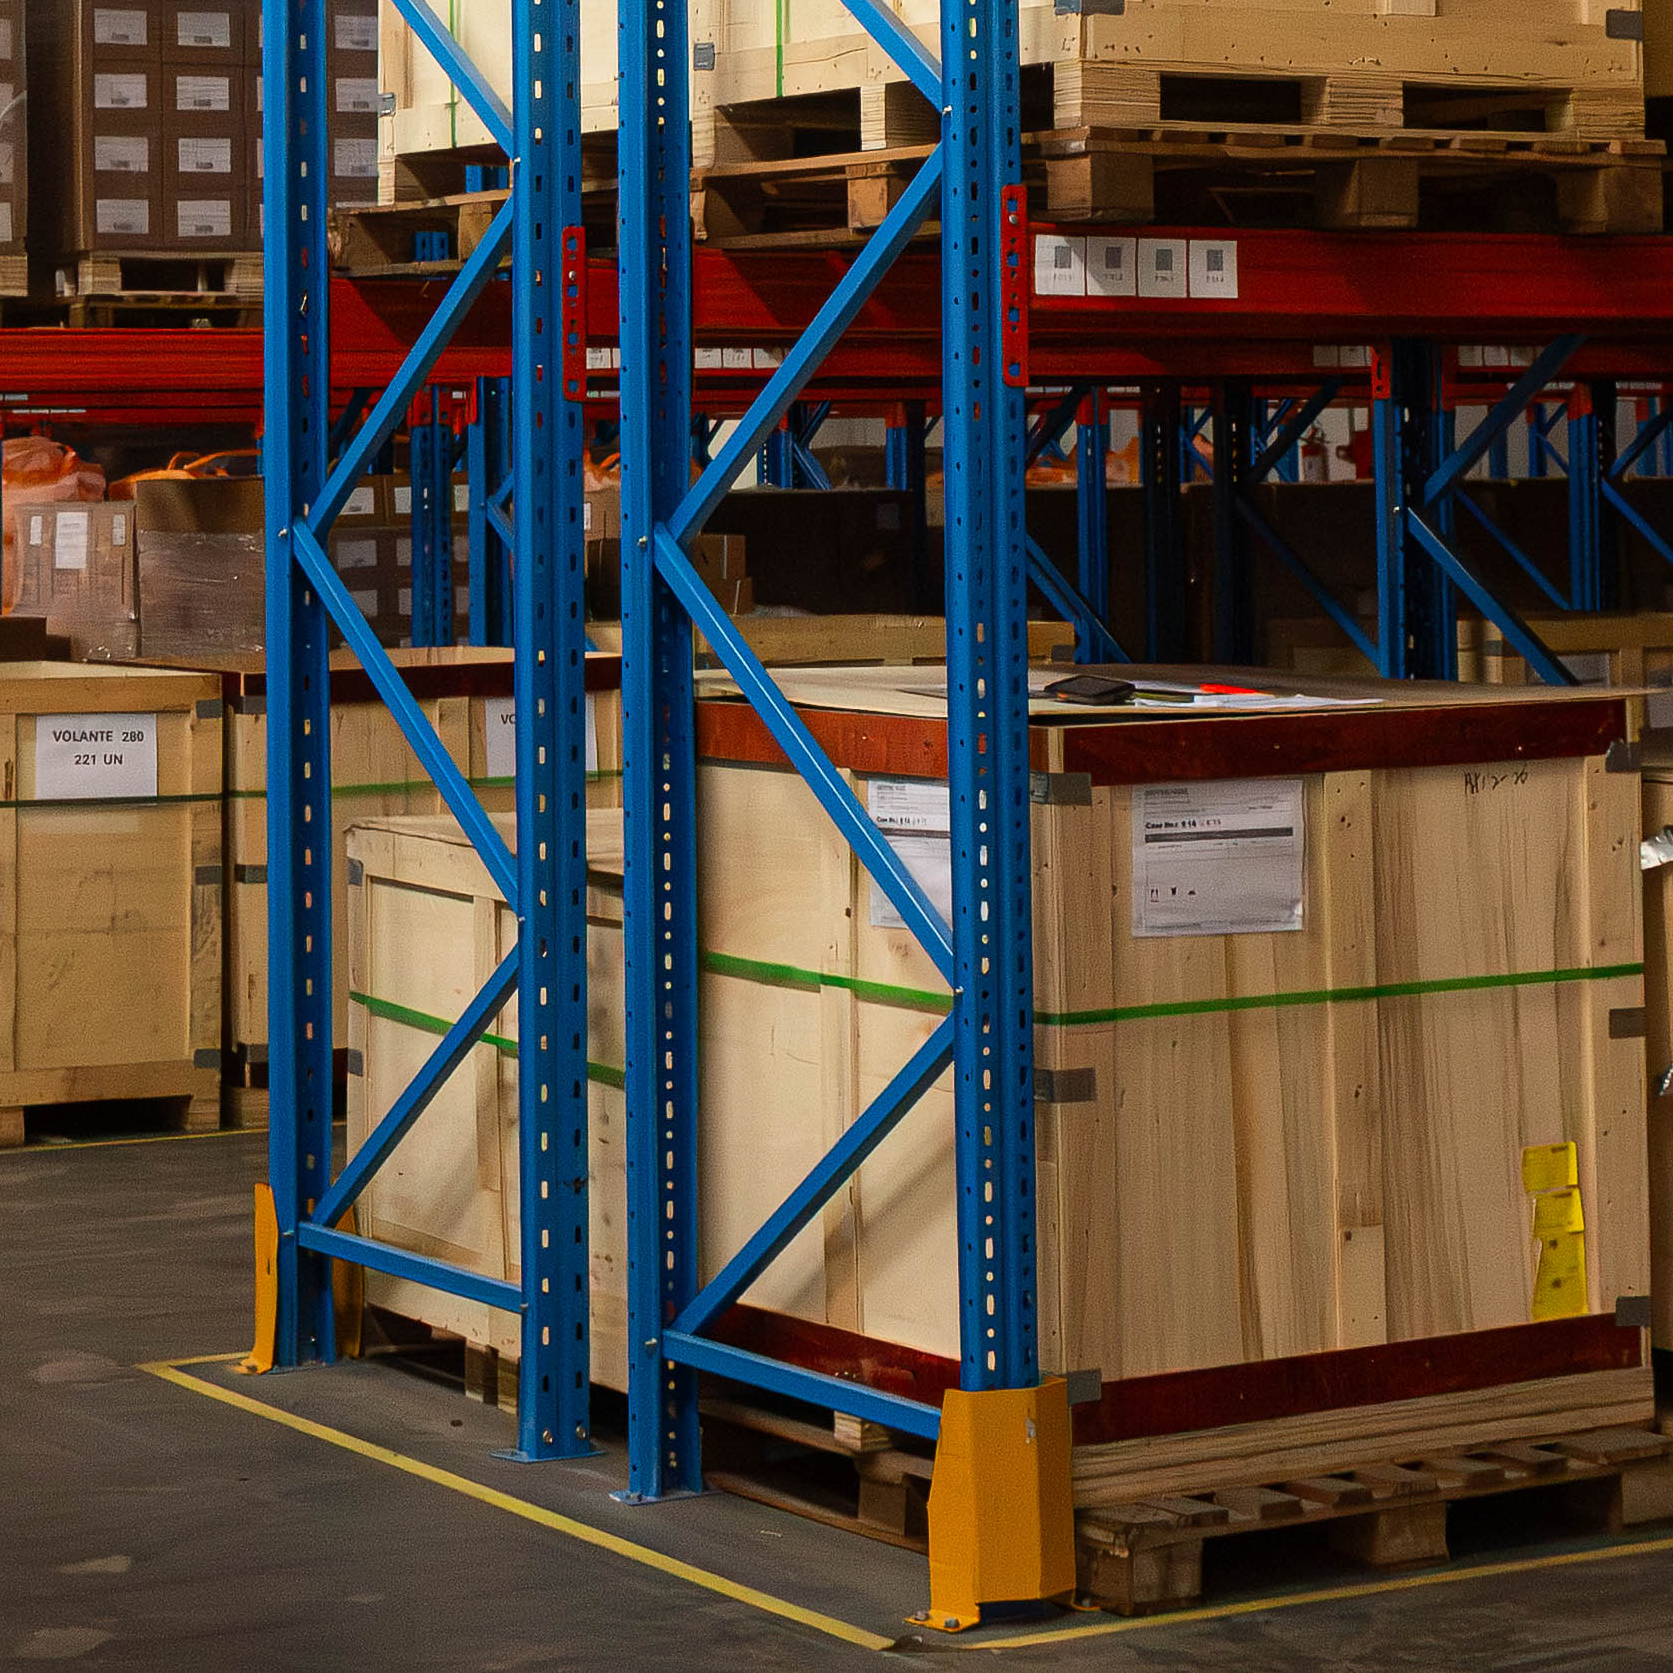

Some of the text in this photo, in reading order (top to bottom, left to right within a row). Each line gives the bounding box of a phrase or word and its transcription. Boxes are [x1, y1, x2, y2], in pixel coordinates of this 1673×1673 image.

[52, 730, 144, 743] VOLANTE 280
[74, 753, 123, 765] 221 UN
